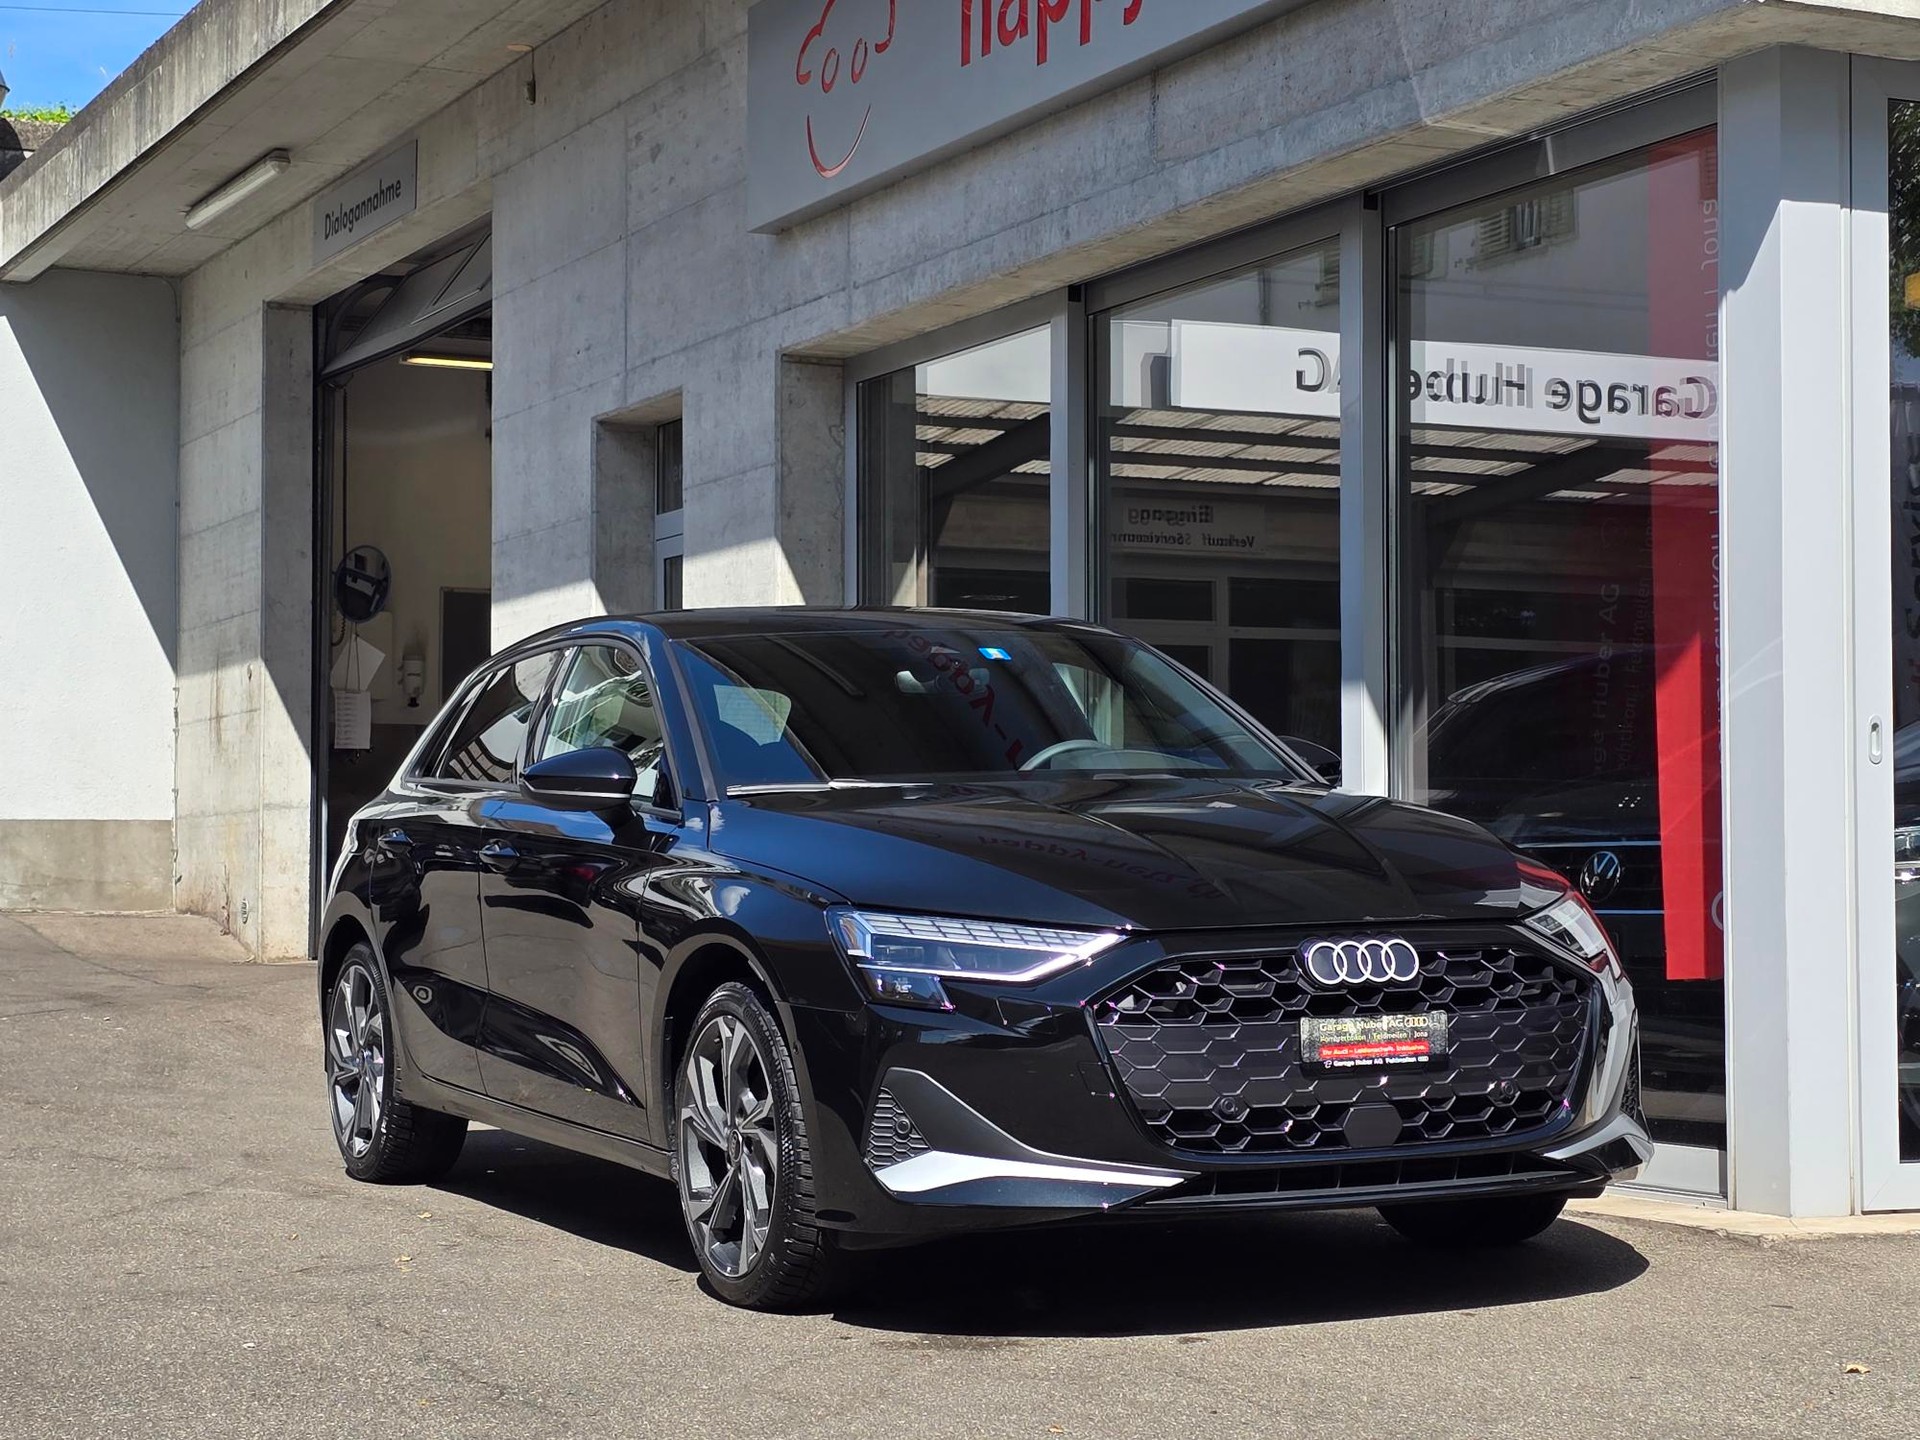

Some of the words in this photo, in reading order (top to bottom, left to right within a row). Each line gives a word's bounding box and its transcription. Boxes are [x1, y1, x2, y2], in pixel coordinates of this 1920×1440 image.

[324, 179, 402, 240] Dialogannahme
[1598, 583, 1620, 626] AG
[1389, 1019, 1403, 1028] AG
[1414, 1030, 1428, 1039] Jona
